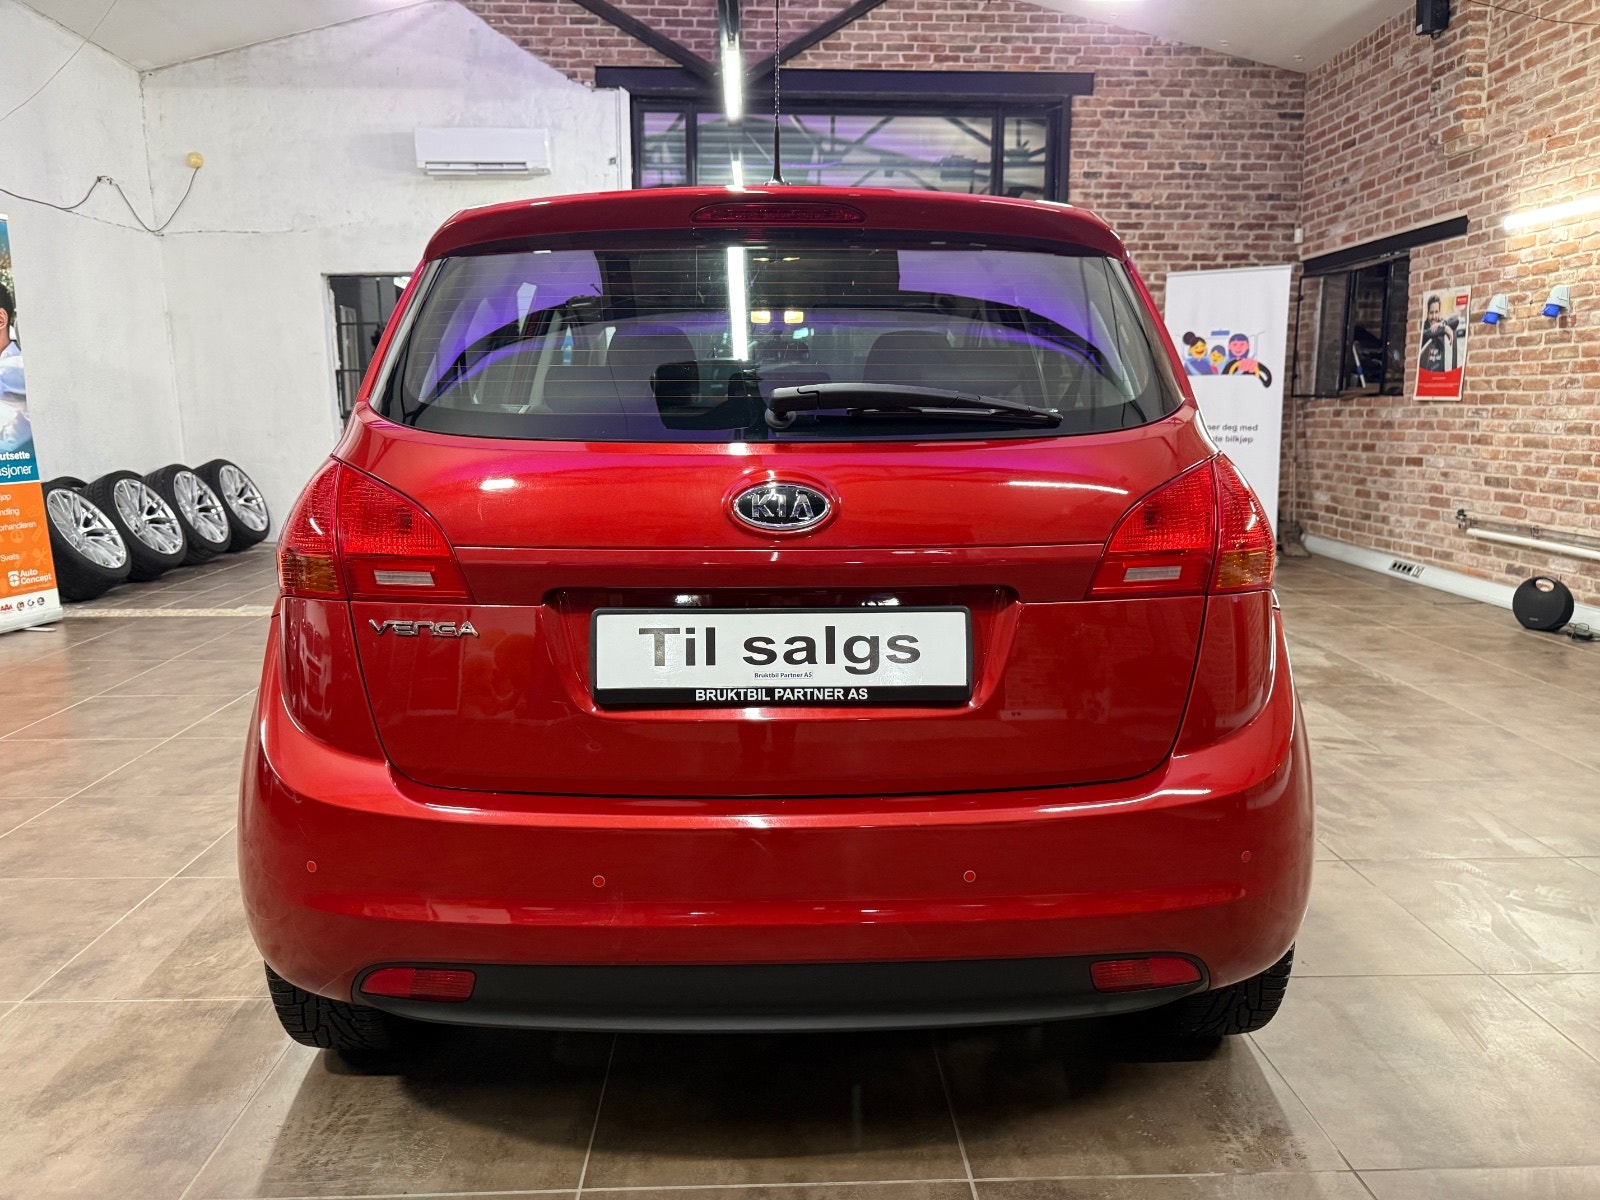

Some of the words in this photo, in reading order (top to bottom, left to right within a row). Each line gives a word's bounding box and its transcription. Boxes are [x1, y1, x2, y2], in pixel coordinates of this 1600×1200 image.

[1222, 424, 1237, 432] deg
[0, 464, 32, 478] sjoner
[751, 491, 814, 519] KIA
[20, 569, 38, 578] Auto
[20, 573, 52, 585] Concept
[638, 626, 716, 666] Til
[742, 625, 921, 675] salgs
[754, 671, 779, 679] Bruktbil
[780, 671, 803, 679] Partner
[695, 688, 771, 702] BRUKTBIL
[774, 688, 844, 701] PARTNER
[848, 688, 868, 700] AS
